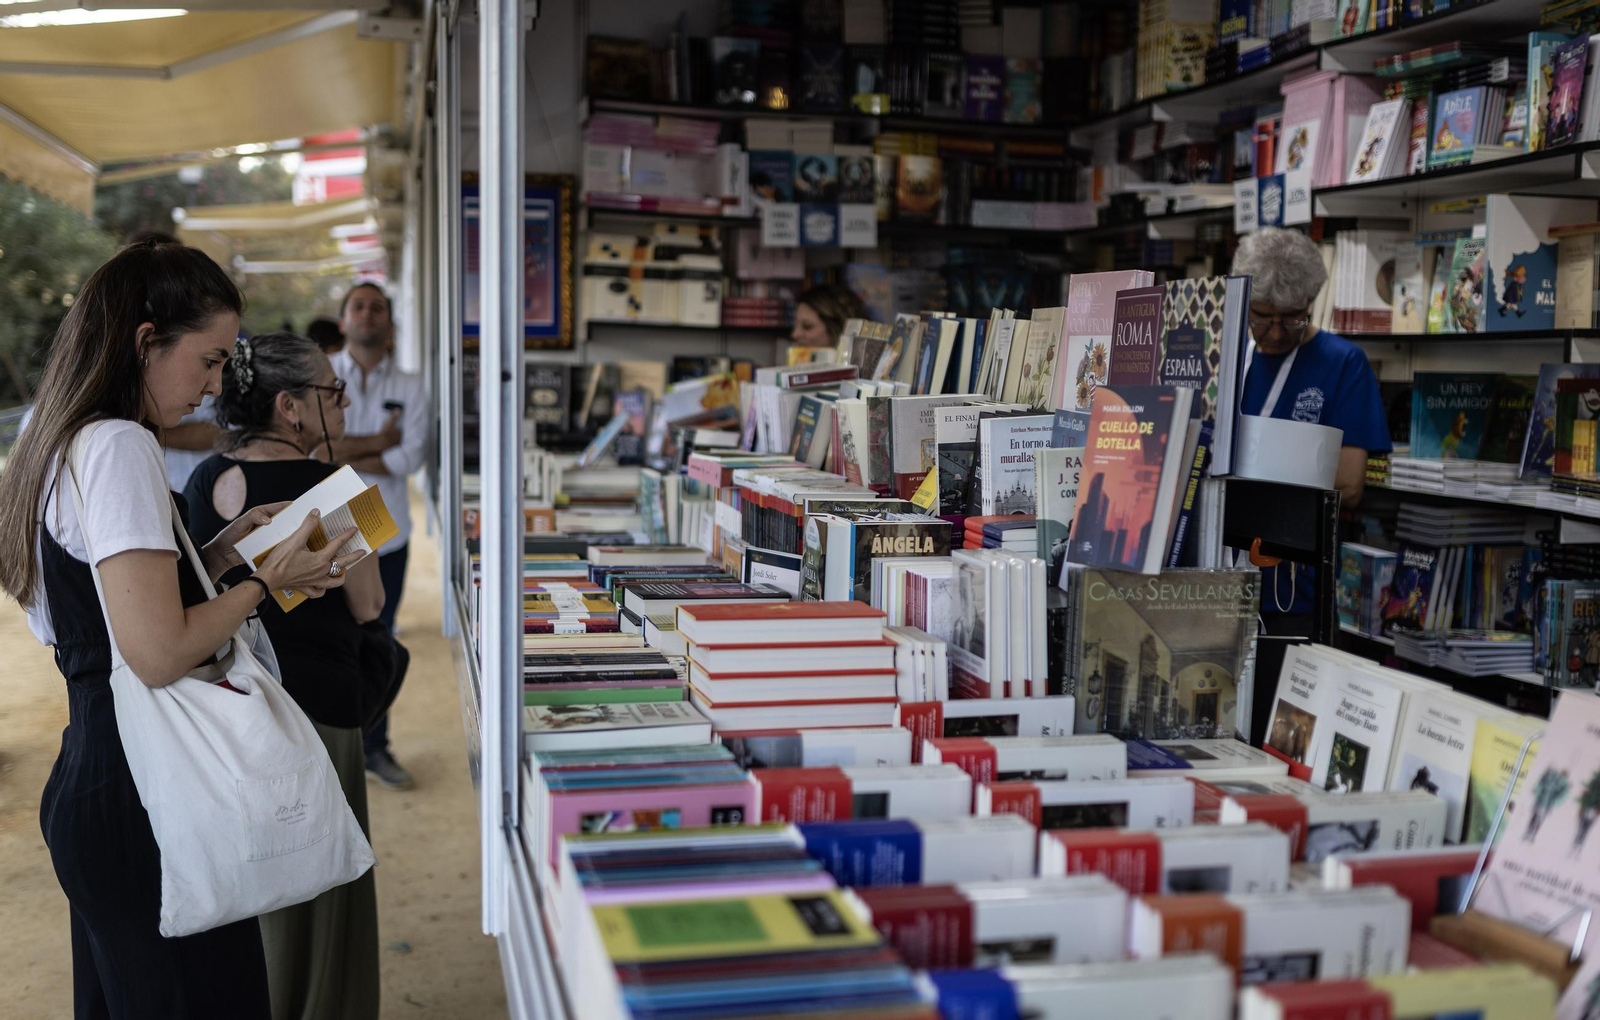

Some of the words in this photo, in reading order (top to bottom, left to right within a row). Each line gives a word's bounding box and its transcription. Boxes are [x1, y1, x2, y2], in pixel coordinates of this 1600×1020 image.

[1126, 303, 1156, 318] ANTIGUA
[1116, 321, 1153, 346] ROMA
[1122, 350, 1151, 360] CINCUENTA
[1113, 362, 1150, 374] MONUMENTOS
[1165, 355, 1203, 377] ESPAÑA
[1164, 380, 1202, 390] MONUMENTAL
[1440, 382, 1458, 396] UN
[1460, 382, 1484, 396] REY
[1426, 396, 1447, 410] SIN
[1072, 419, 1086, 432] Gullo
[1099, 421, 1138, 434] CUELLO
[1139, 422, 1155, 434] DE
[1010, 438, 1020, 450] En
[1022, 439, 1044, 449] torno
[1096, 437, 1141, 450] BOTELLA
[1000, 452, 1035, 464] murallas
[1194, 445, 1206, 468] CONTRA
[1058, 473, 1068, 485] J.
[1060, 489, 1078, 498] CON
[871, 534, 934, 554] ÁNGELA
[808, 552, 814, 565] LA
[752, 568, 765, 578] Jordi
[765, 571, 777, 580] Soler
[1089, 582, 1143, 601] CASAS
[1146, 577, 1254, 601] SEVILLANAS
[1574, 600, 1600, 617] AR
[1341, 698, 1354, 710] Auge
[1359, 707, 1376, 720] caída
[1336, 709, 1345, 718] del
[1345, 713, 1362, 727] conejo
[1418, 723, 1427, 734] La
[1427, 726, 1447, 744] buena
[1447, 735, 1465, 751] letra
